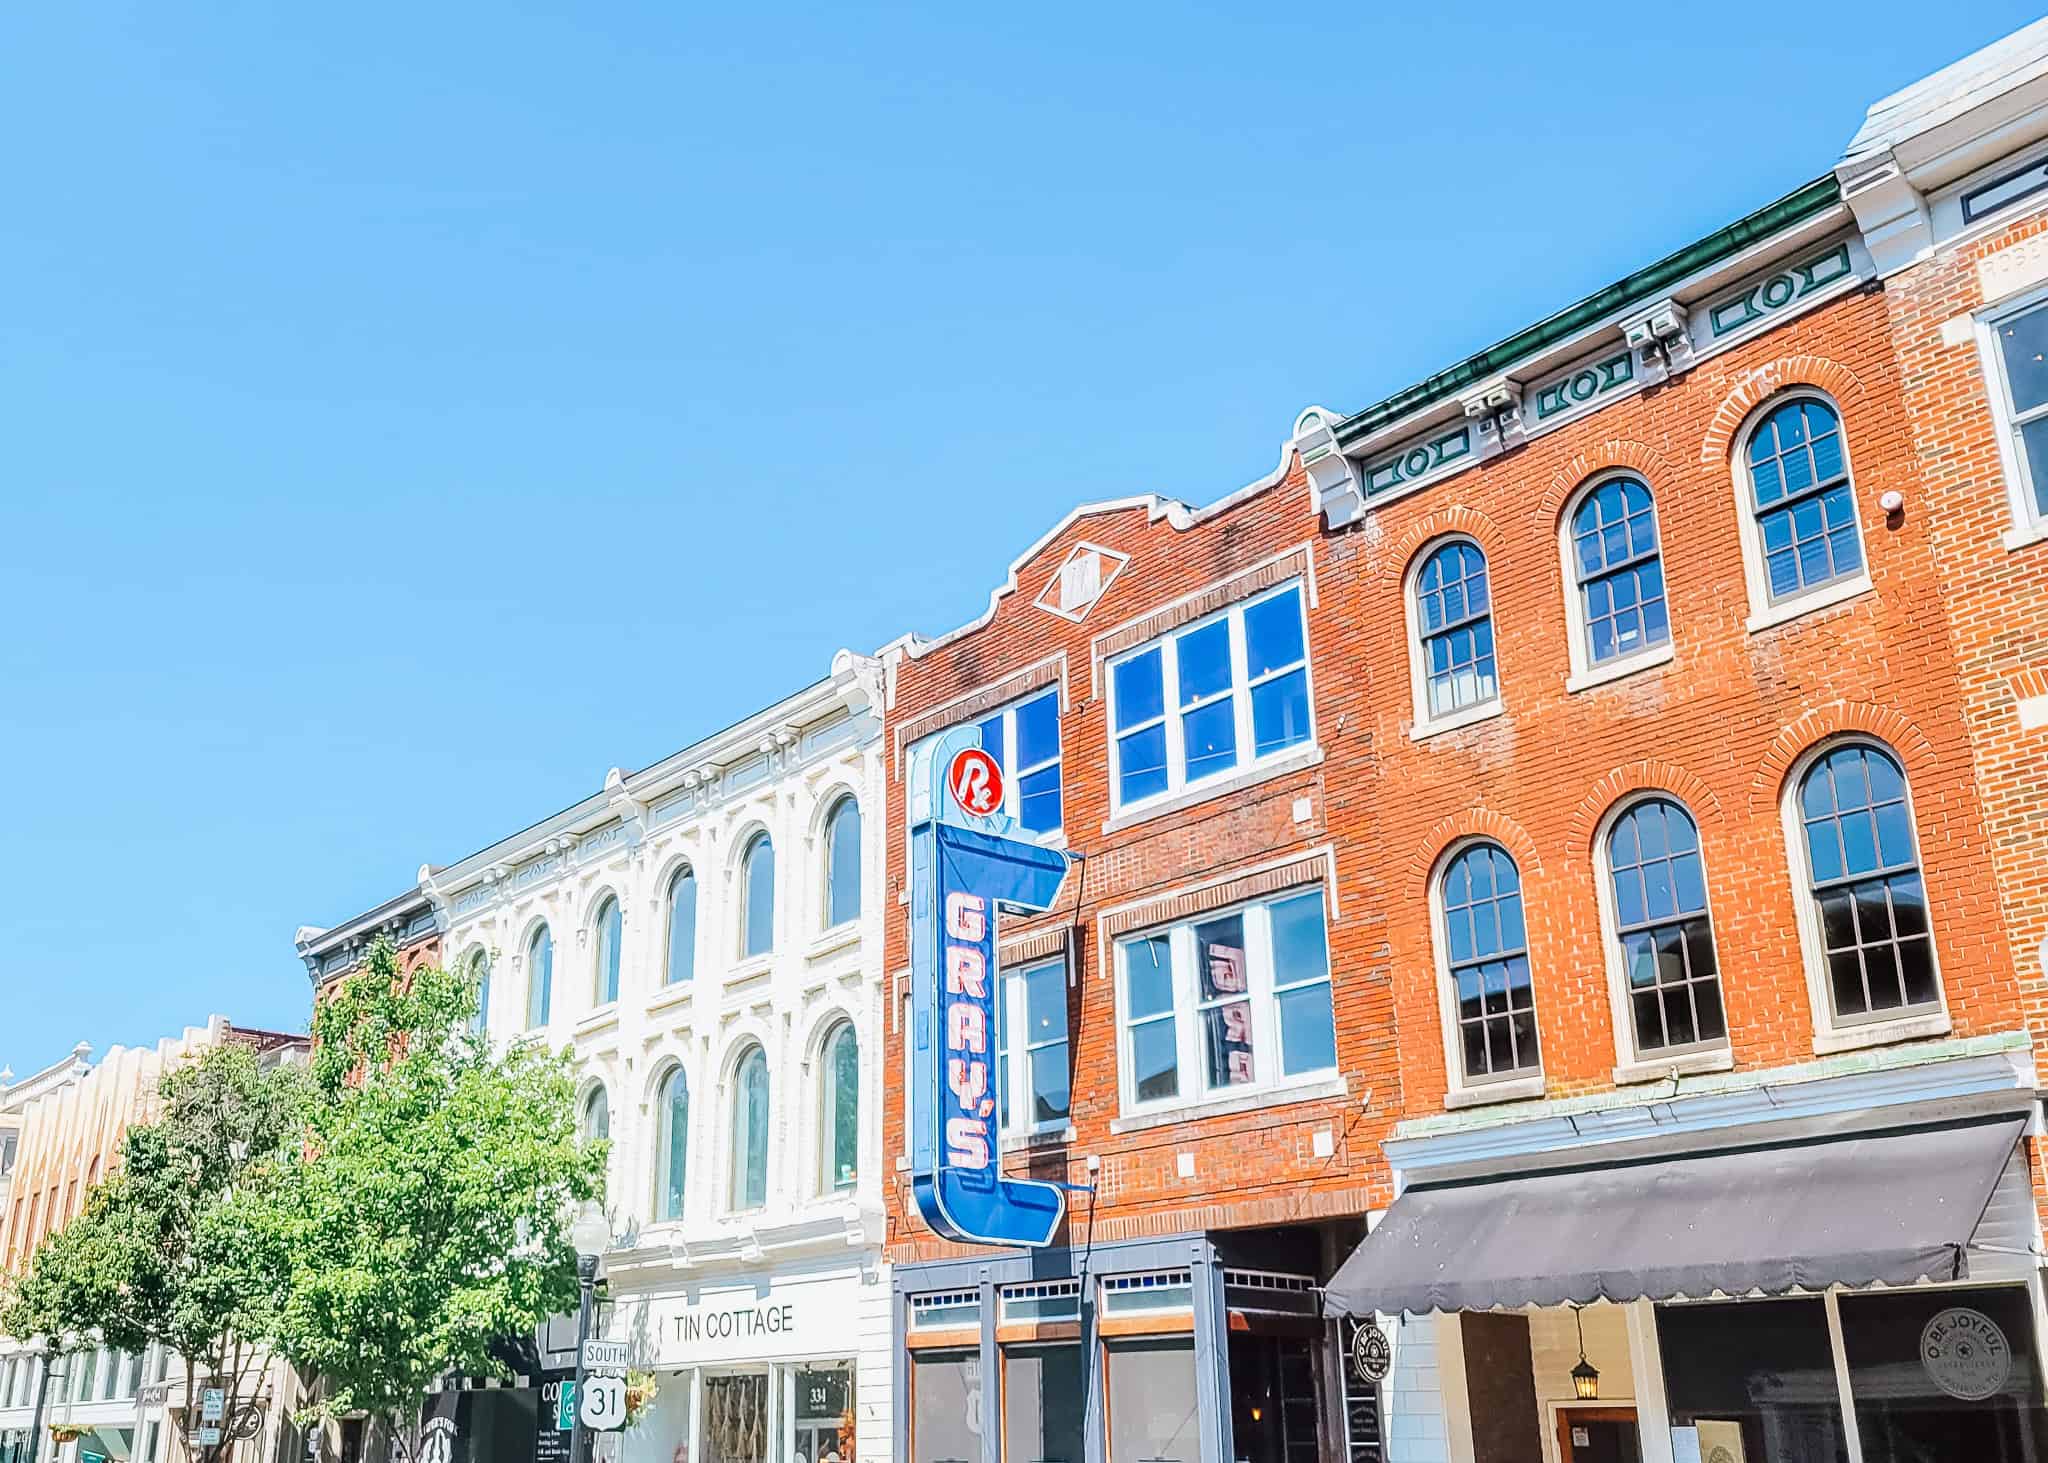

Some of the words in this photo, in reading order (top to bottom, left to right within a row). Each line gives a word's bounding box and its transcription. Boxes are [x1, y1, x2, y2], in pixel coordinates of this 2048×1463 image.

[946, 891, 994, 1169] GRAY'S
[674, 1314, 700, 1341] TIN
[706, 1304, 793, 1338] COTTAGE
[1950, 1314, 2002, 1357] JOYFUL
[587, 1345, 626, 1362] SOUTH
[590, 1388, 615, 1415] 31
[810, 1387, 826, 1403] 334
